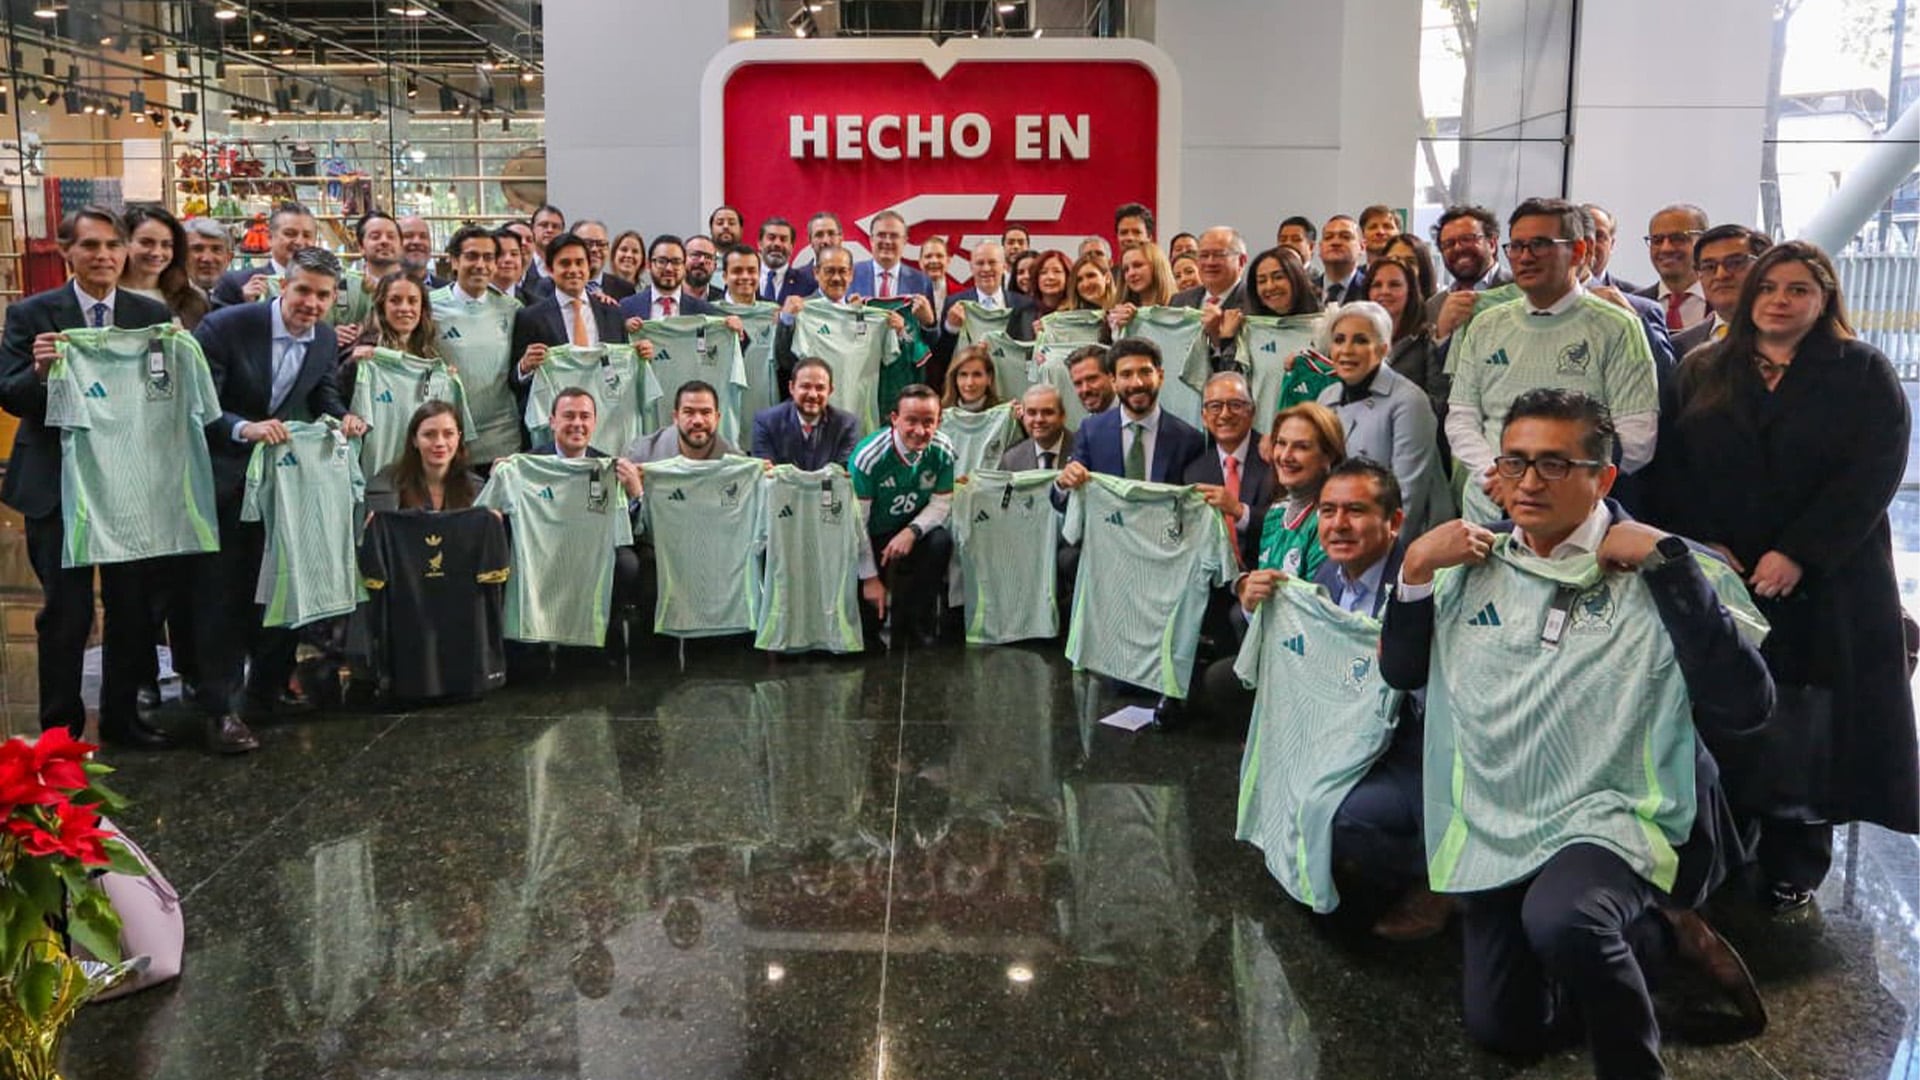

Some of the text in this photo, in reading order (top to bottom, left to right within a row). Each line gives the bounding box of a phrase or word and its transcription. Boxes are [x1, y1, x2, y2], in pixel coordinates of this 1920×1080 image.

[789, 112, 1091, 160] HECHO EN
[889, 491, 919, 516] 26
